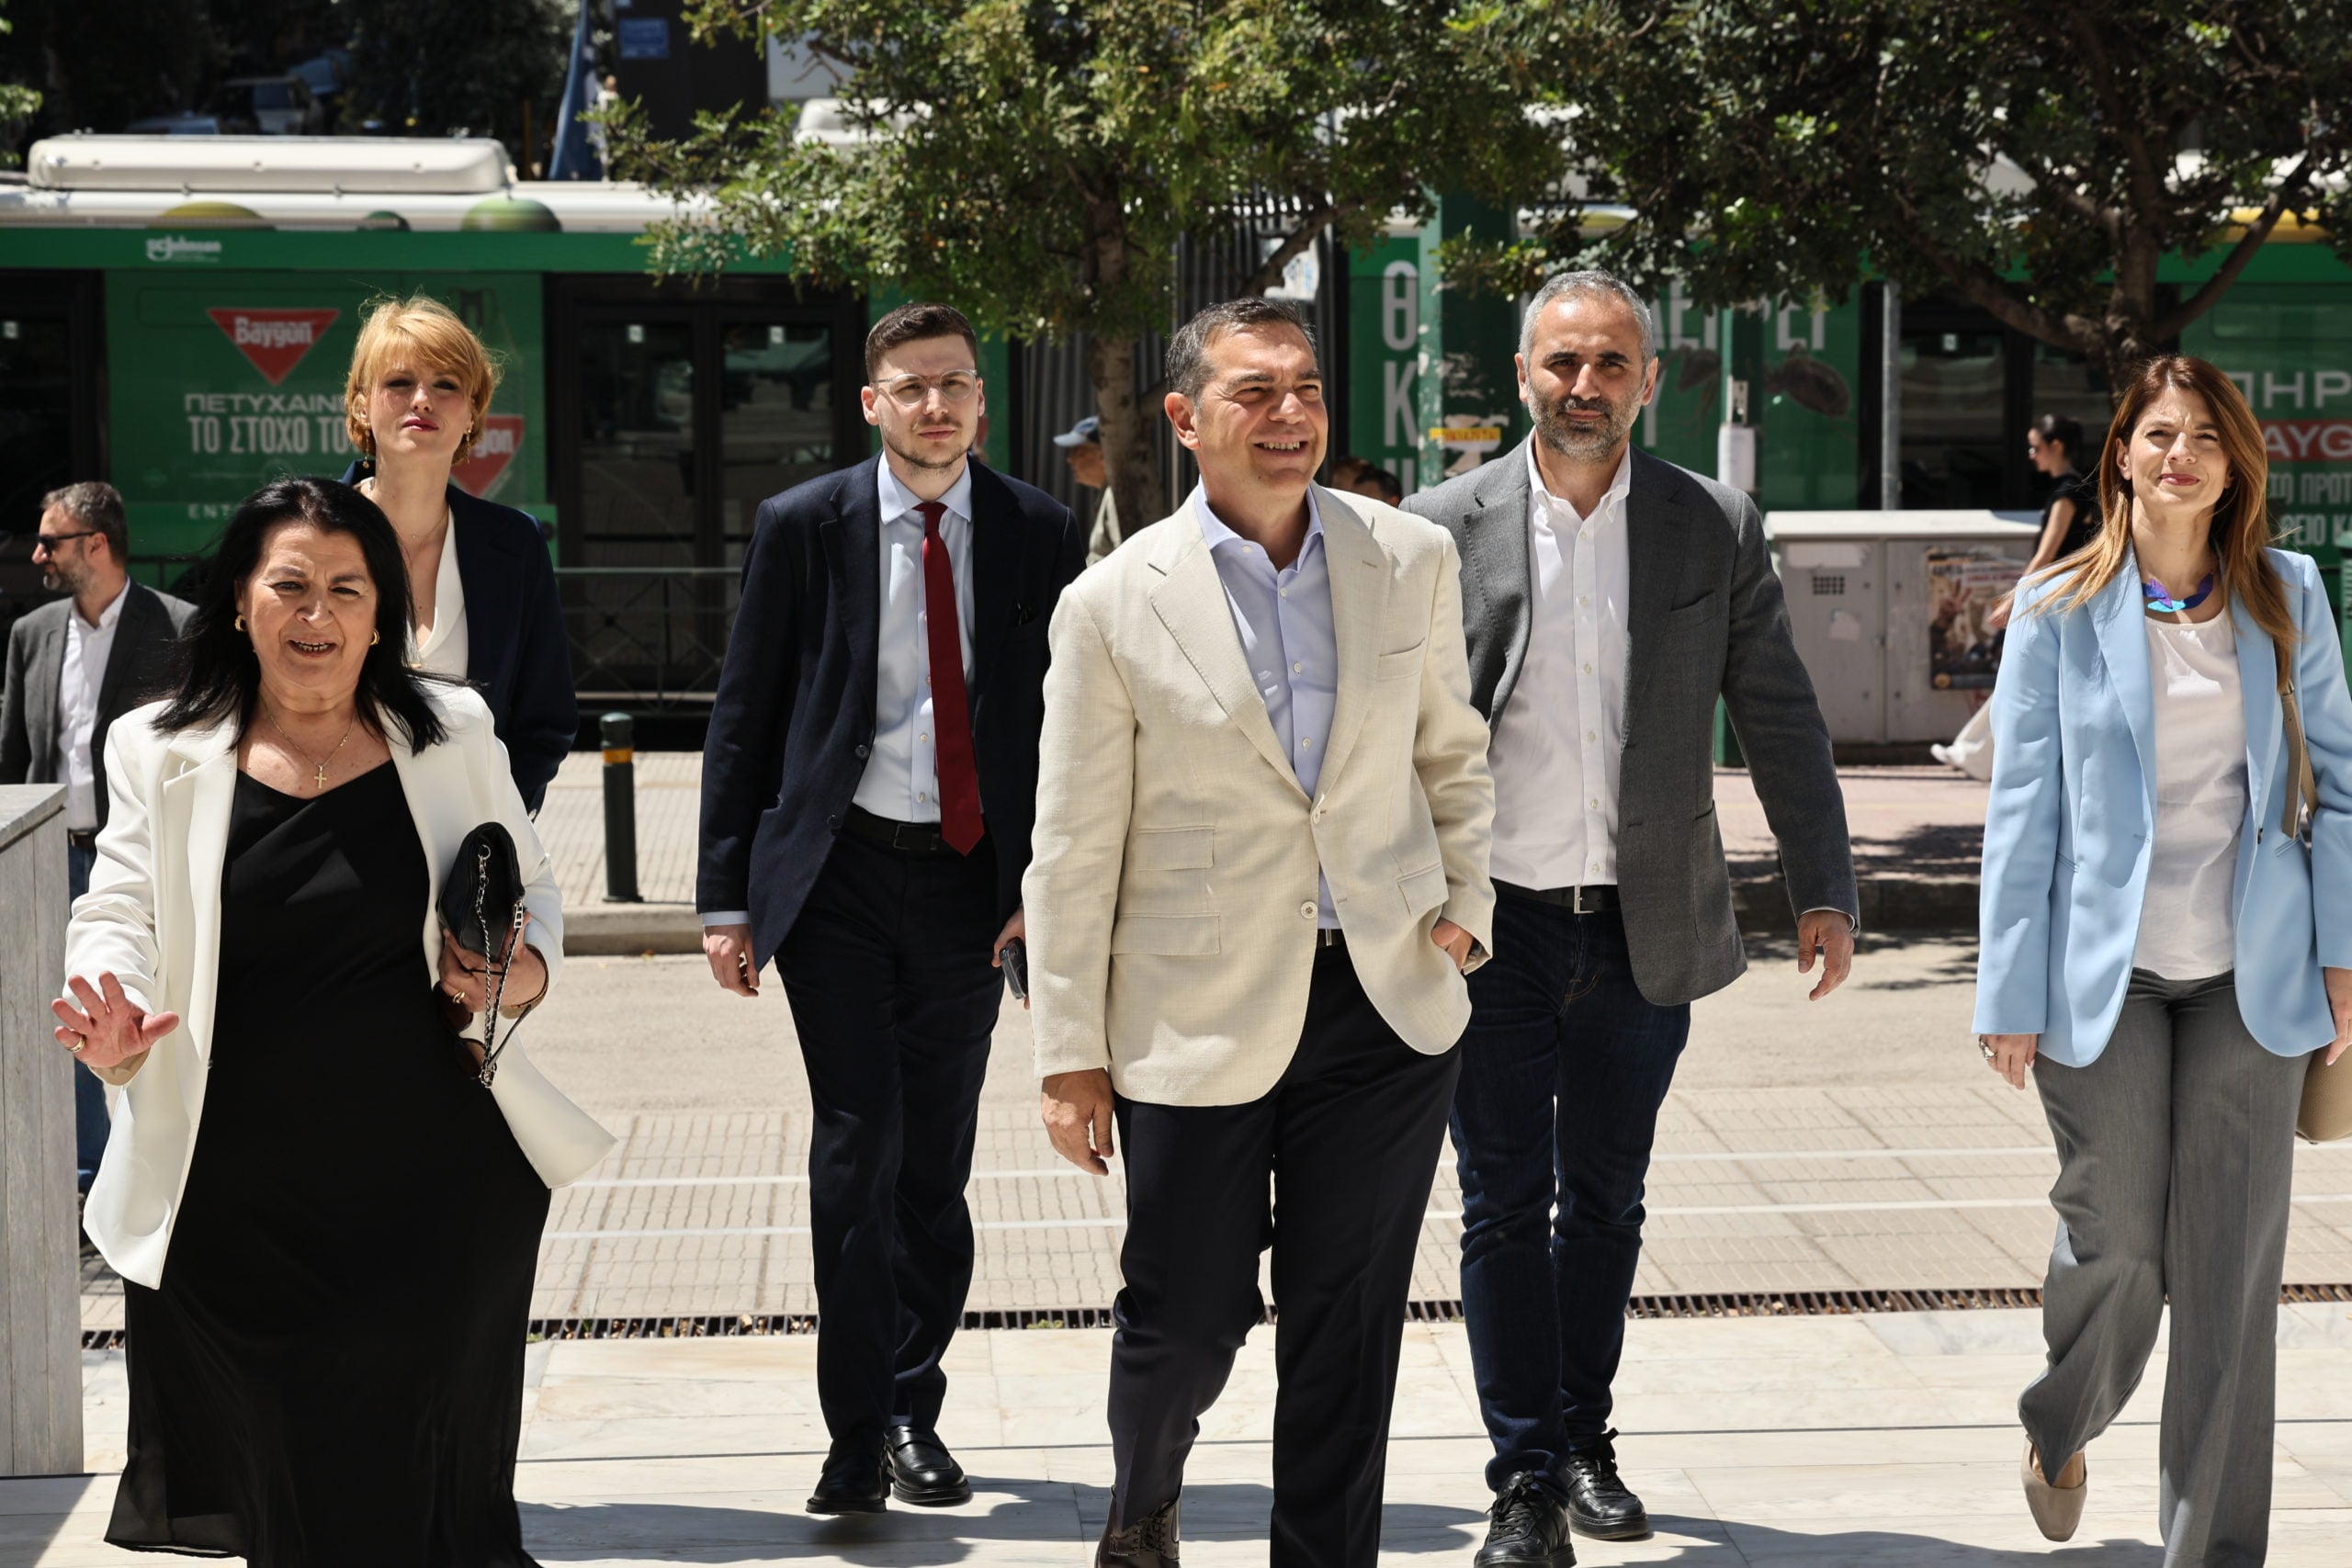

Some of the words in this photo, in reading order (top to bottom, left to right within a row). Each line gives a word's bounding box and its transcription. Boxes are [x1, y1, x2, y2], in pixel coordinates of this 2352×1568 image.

[234, 317, 313, 348] Baygon
[187, 416, 220, 454] ΤΟ
[230, 416, 309, 454] ΣΤΟΧΟ
[316, 416, 359, 454] ΤΟ
[474, 429, 514, 458] gon
[2264, 423, 2352, 457] AYG
